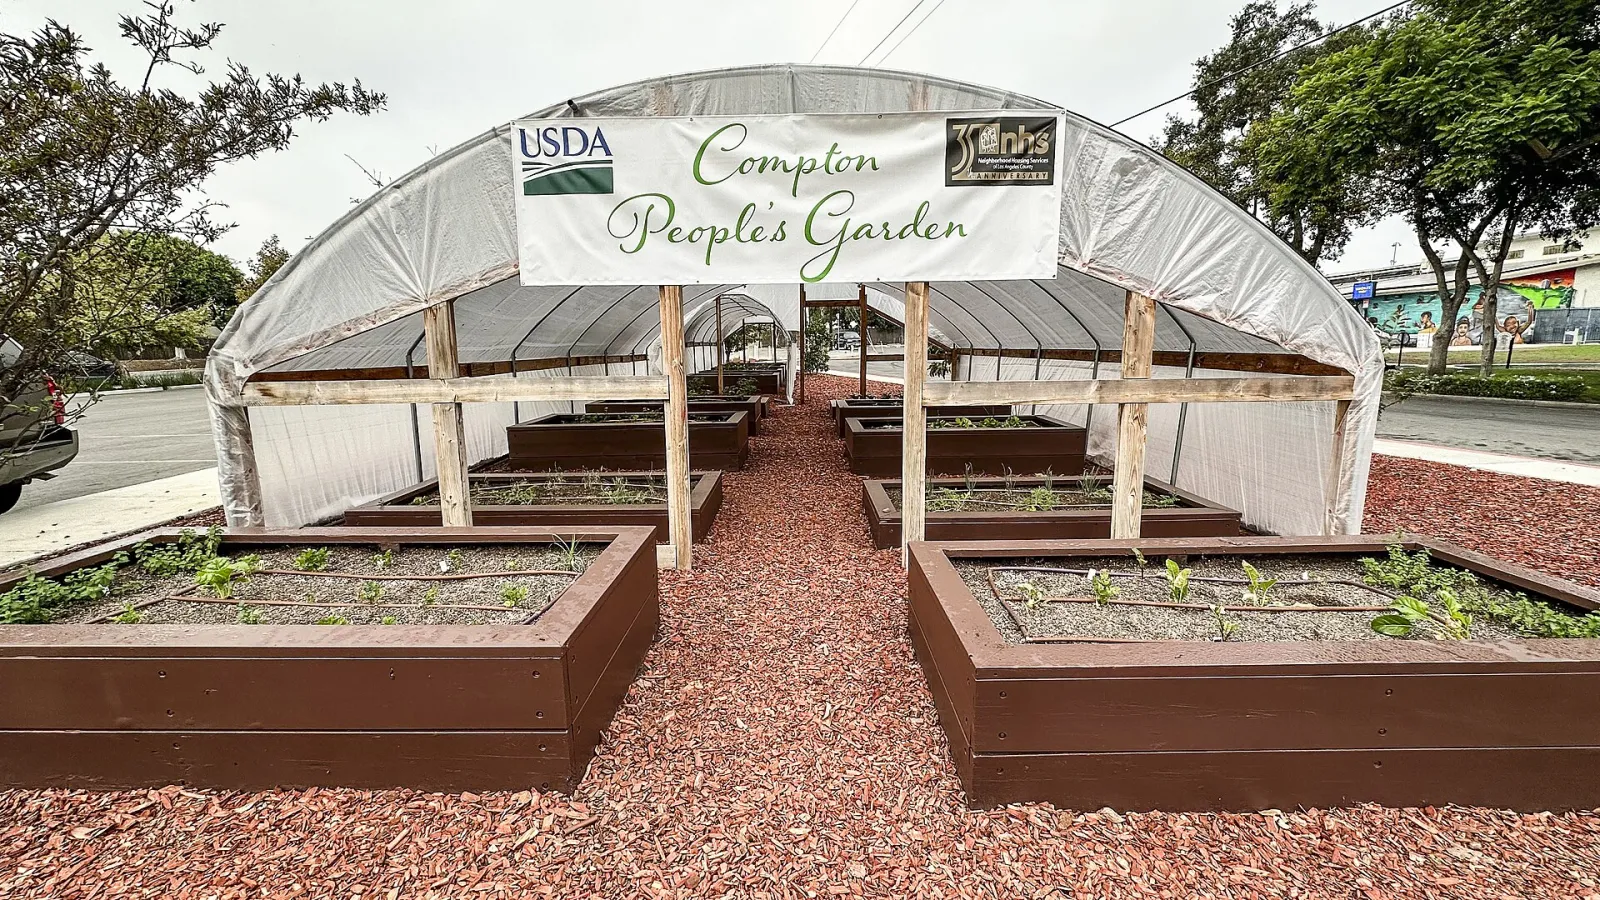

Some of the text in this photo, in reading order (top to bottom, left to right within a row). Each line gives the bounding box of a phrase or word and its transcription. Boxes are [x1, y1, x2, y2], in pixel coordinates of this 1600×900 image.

[519, 126, 614, 158] USDA
[1000, 125, 1050, 154] nhs
[693, 122, 880, 198] Compton
[978, 157, 1011, 165] Neighborhood
[1012, 157, 1029, 165] Housing
[606, 190, 968, 282] People's Garden
